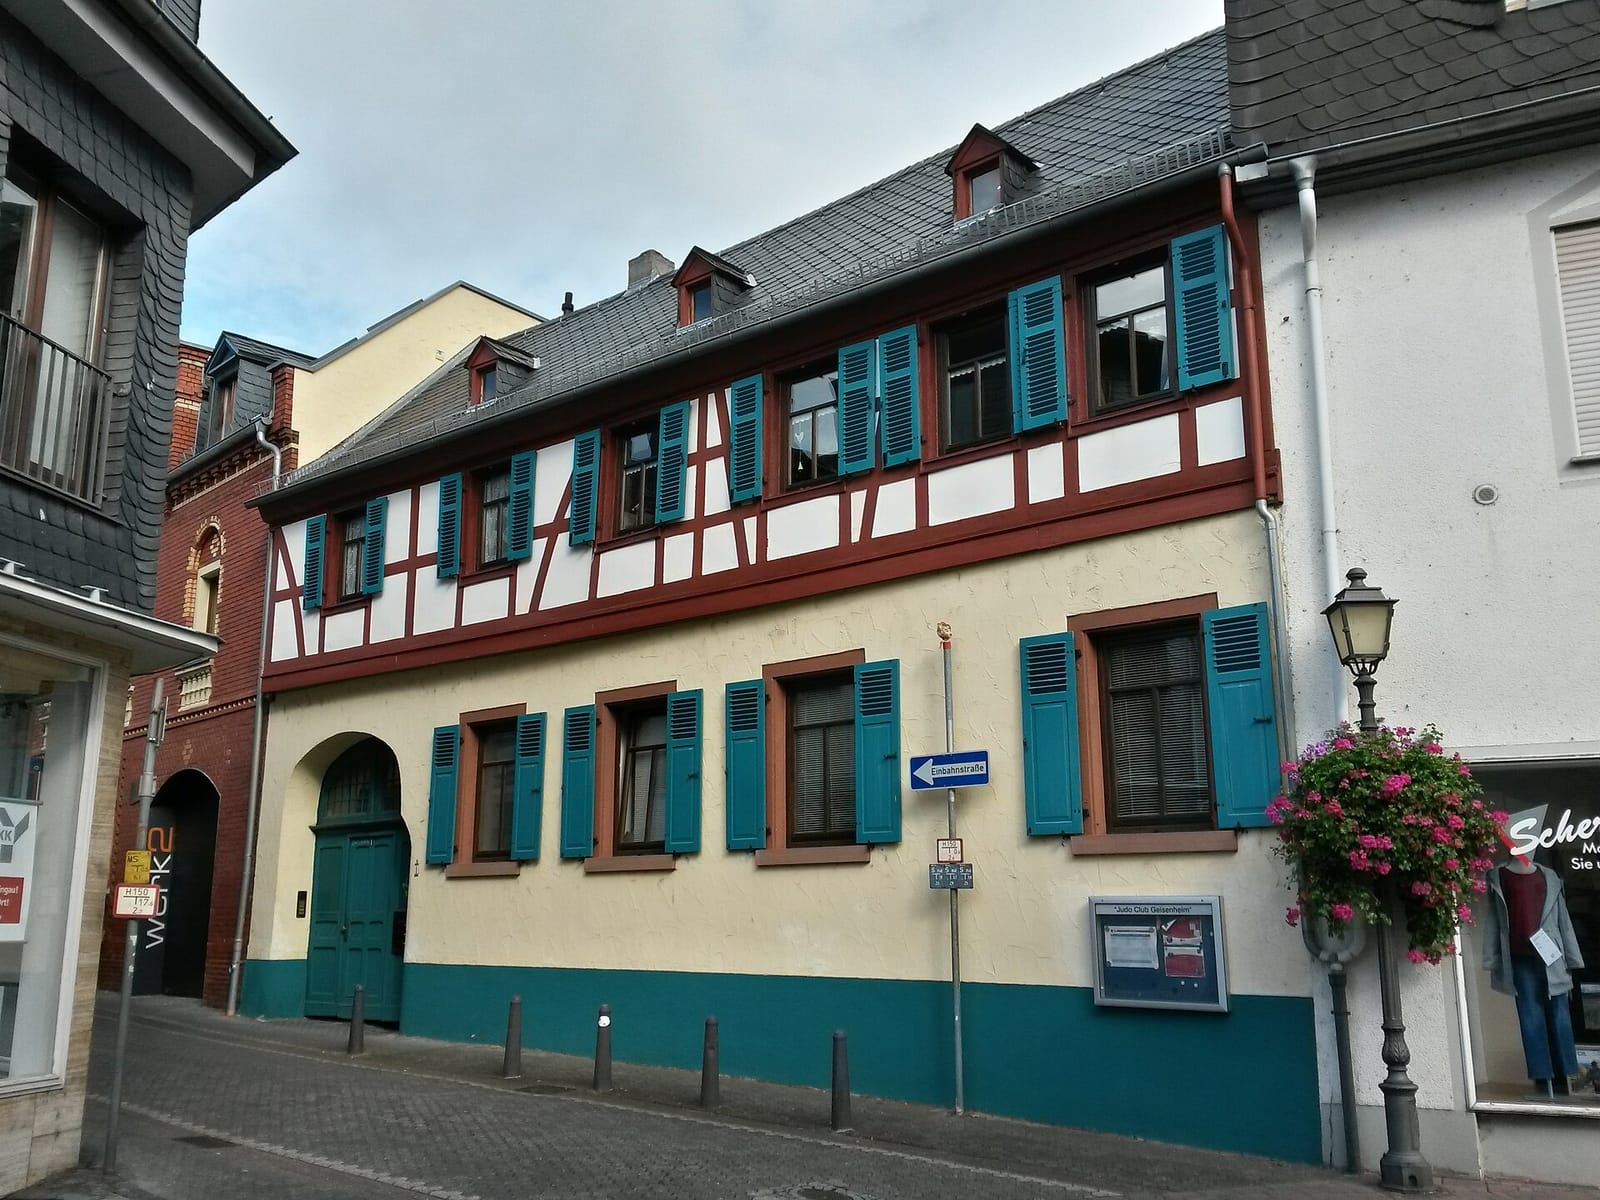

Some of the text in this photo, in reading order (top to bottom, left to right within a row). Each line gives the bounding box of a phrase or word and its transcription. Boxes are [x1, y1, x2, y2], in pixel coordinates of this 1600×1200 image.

[931, 764, 985, 776] Einbahnstraße
[1571, 858, 1593, 870] Sie
[125, 888, 149, 896] H150
